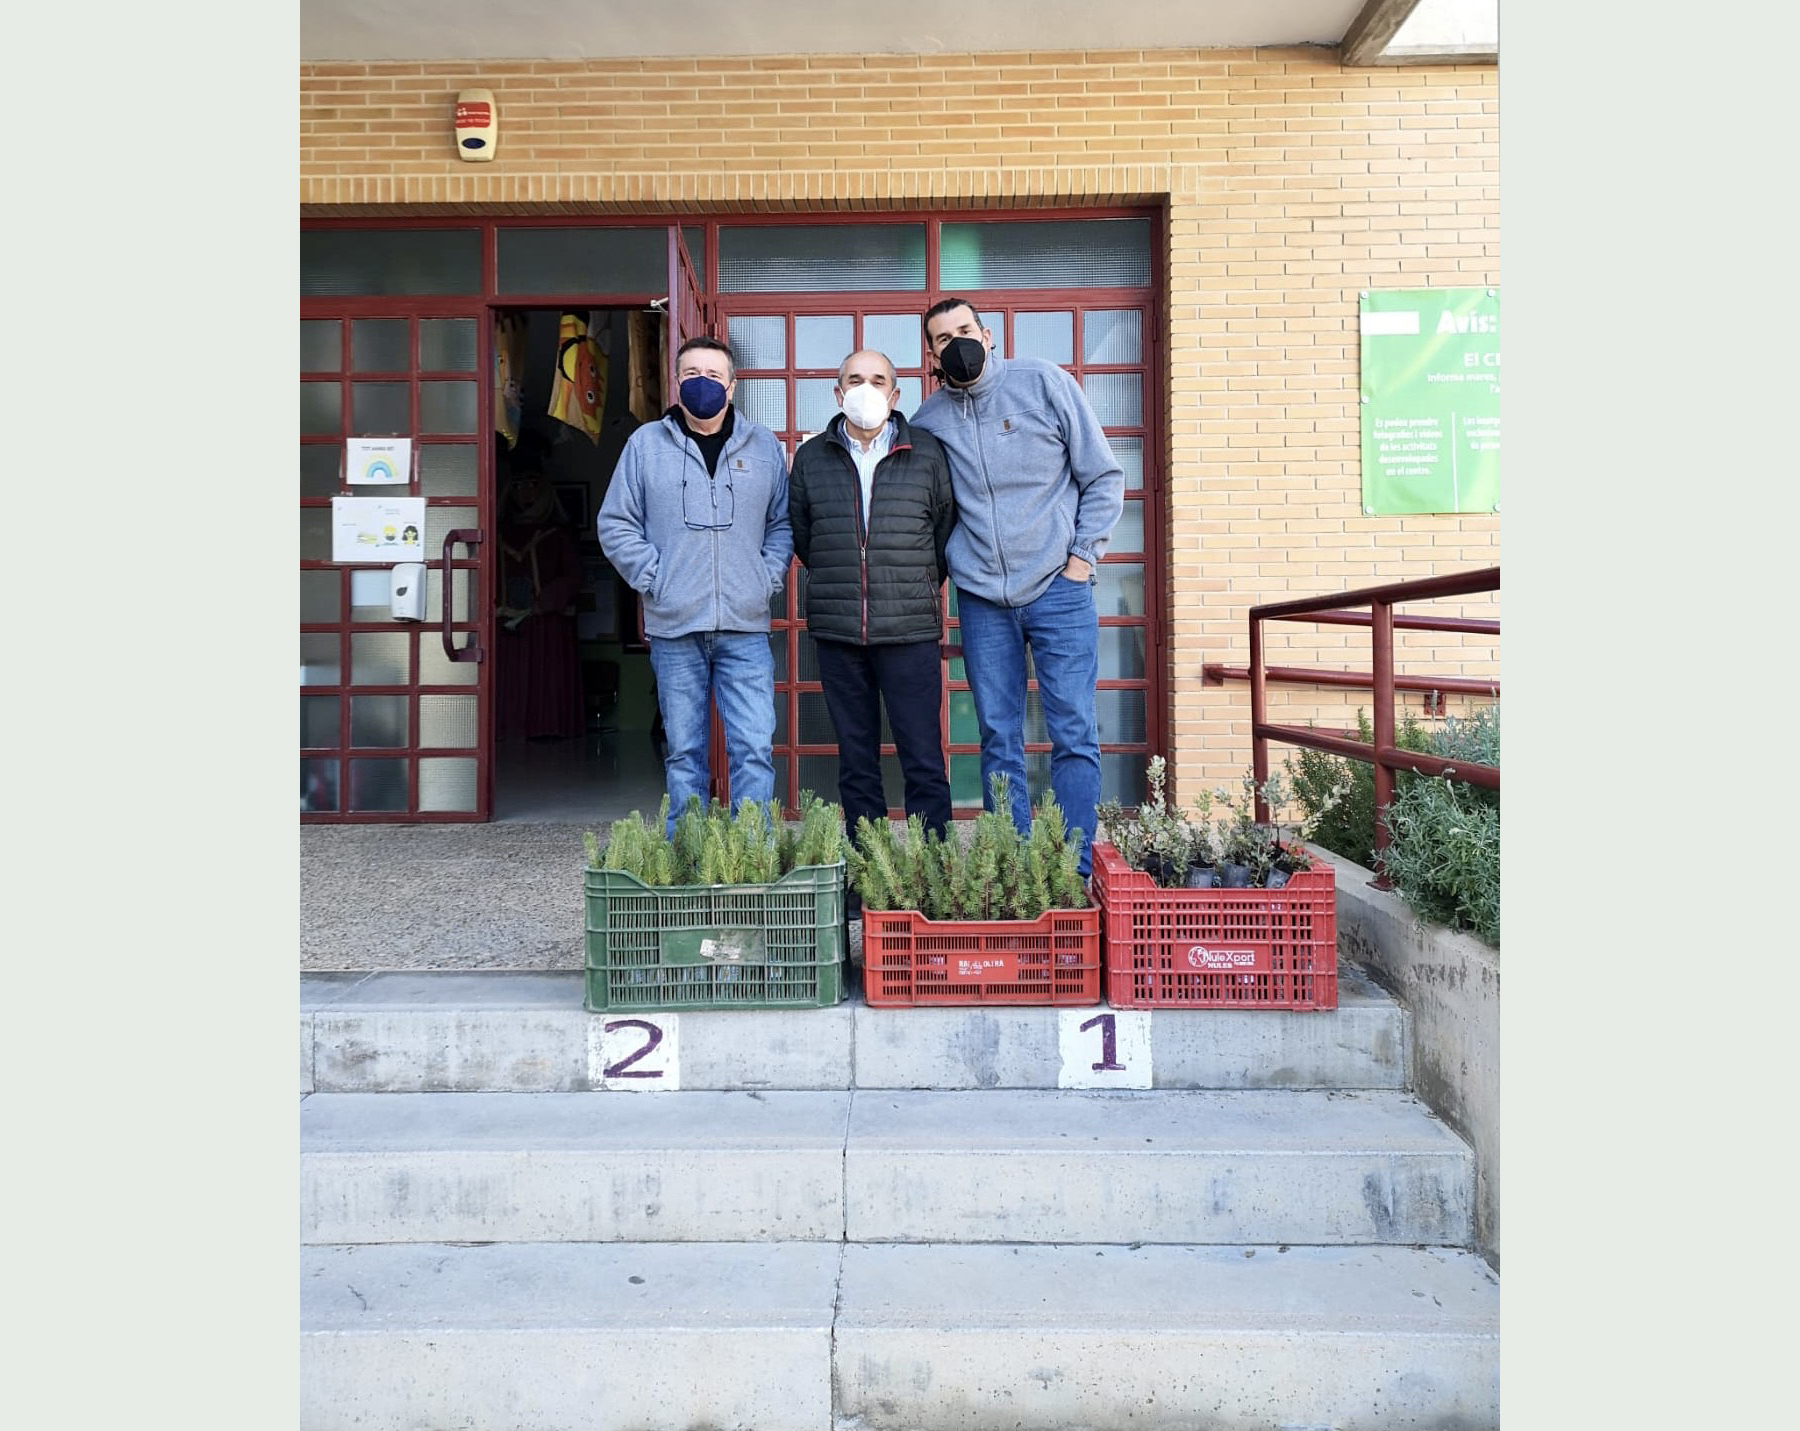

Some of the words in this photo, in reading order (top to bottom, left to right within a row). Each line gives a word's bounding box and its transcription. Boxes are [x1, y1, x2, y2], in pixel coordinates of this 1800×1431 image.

[1464, 352, 1479, 368] El
[603, 1019, 664, 1079] 2
[1079, 1013, 1127, 1072] 1
